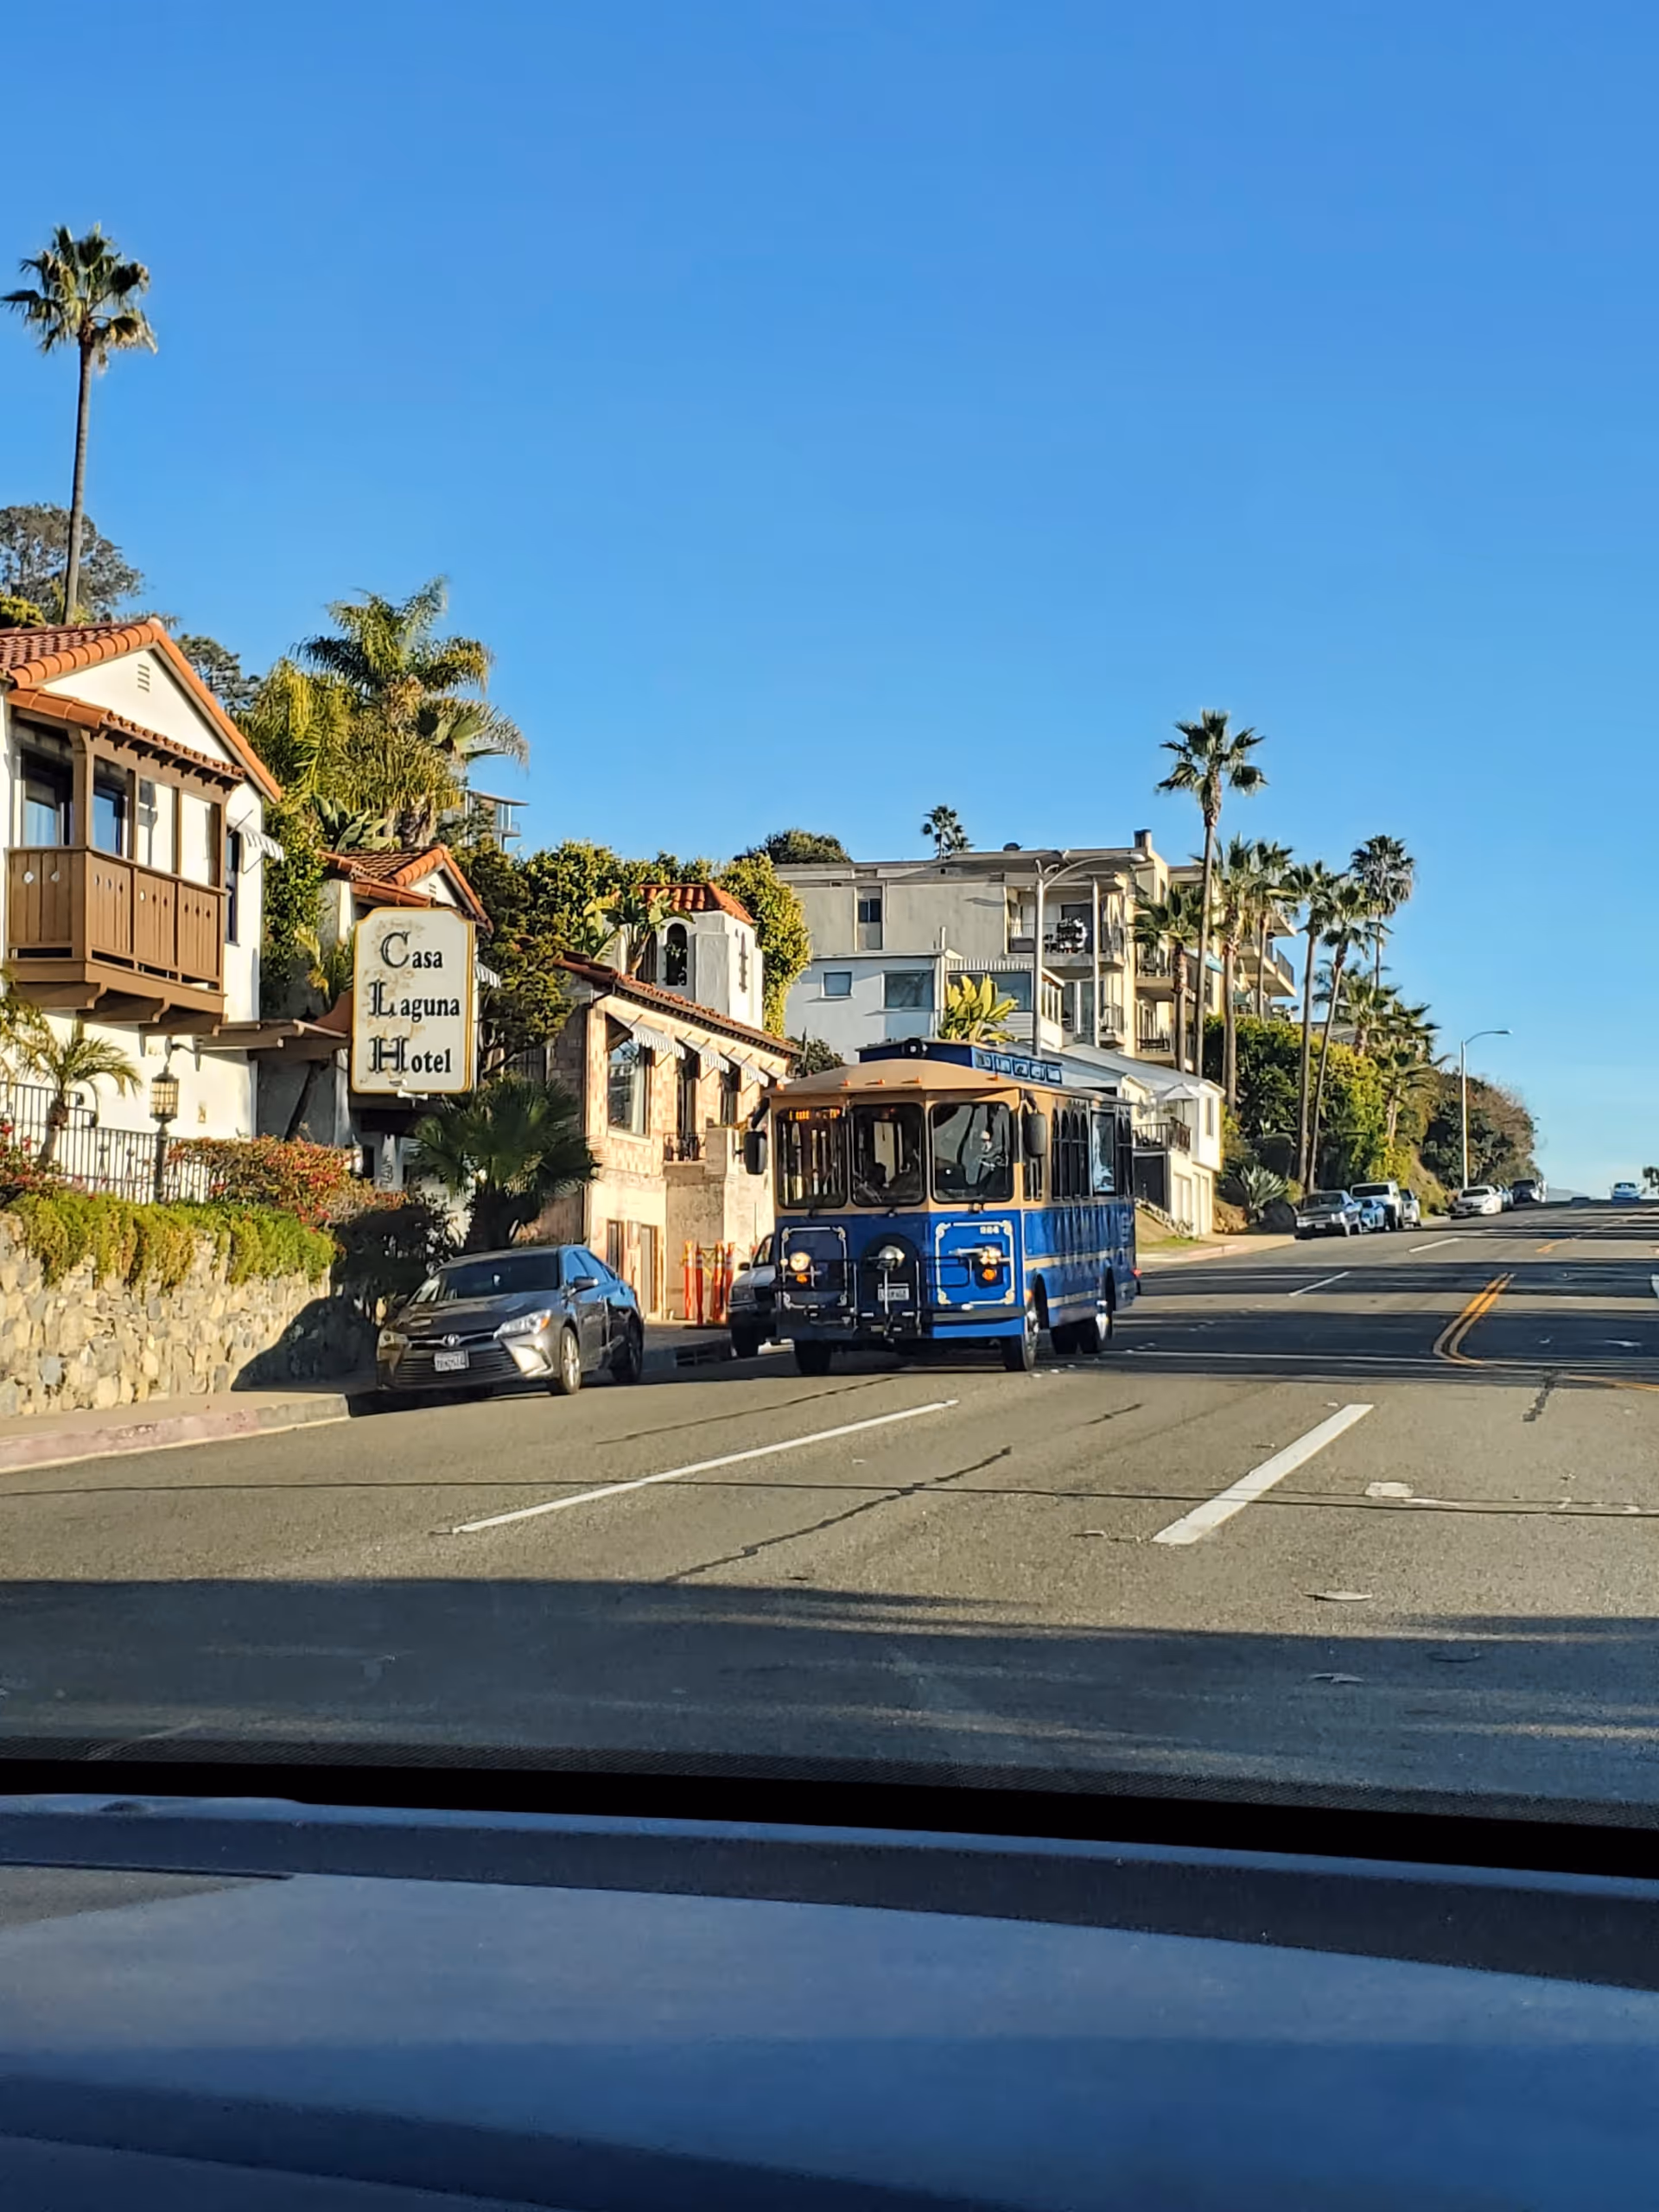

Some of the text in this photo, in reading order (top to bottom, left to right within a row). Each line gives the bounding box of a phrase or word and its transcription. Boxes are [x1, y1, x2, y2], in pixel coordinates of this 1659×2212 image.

[380, 931, 443, 969] Casa
[368, 979, 460, 1023] Laguna
[368, 1035, 451, 1074] Hotel
